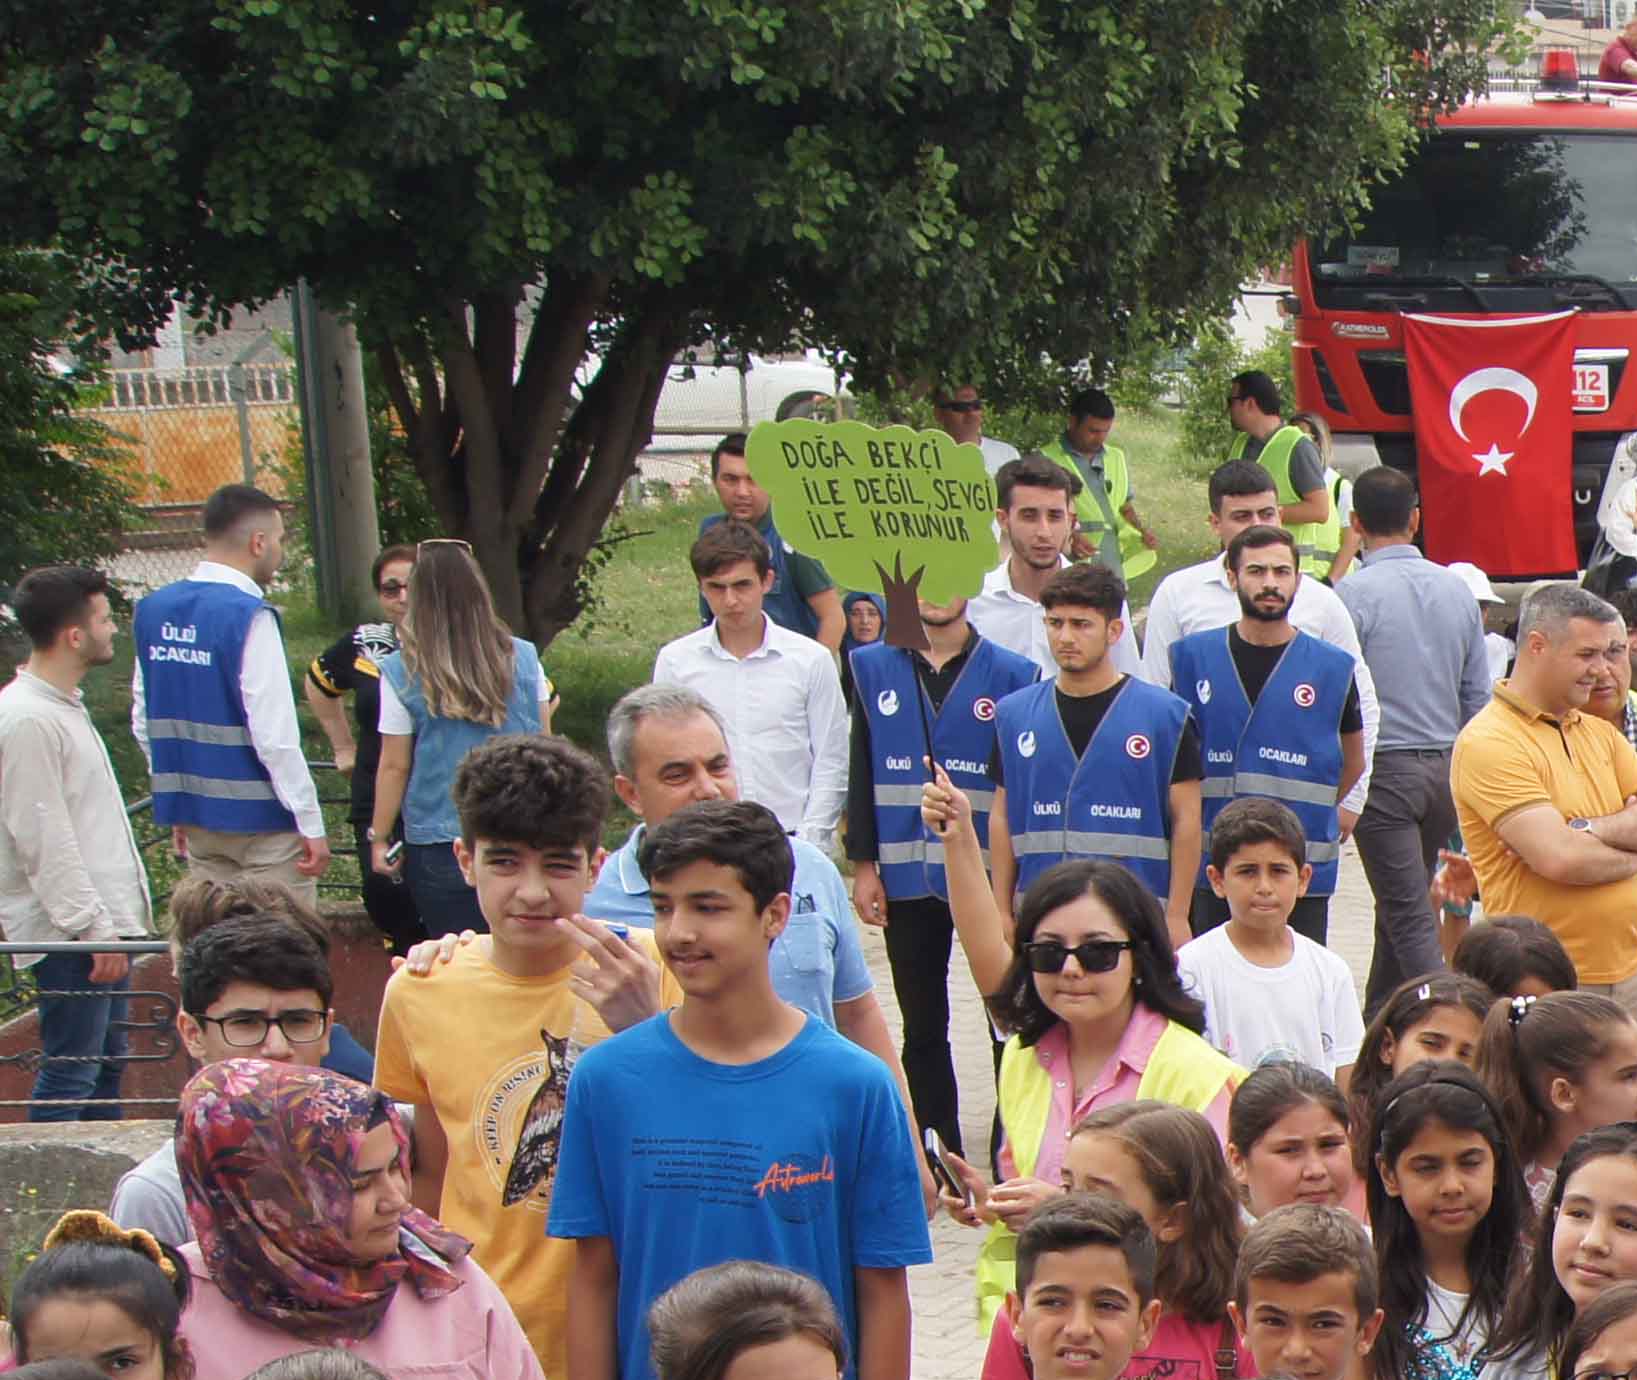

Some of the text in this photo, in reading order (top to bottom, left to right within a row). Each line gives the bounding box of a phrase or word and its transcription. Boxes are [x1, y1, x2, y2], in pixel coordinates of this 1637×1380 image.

[781, 435, 941, 474] DOĞA BEKÇİ
[802, 476, 846, 506] İLE
[932, 478, 995, 512] SEVGİ
[807, 510, 970, 543] İLE KORUNUR
[886, 755, 912, 770] ÜLKÜ
[1207, 746, 1308, 766] ÜLKÜ OCAKLARI
[1033, 801, 1142, 819] ÜLKÜ OCAKLARI
